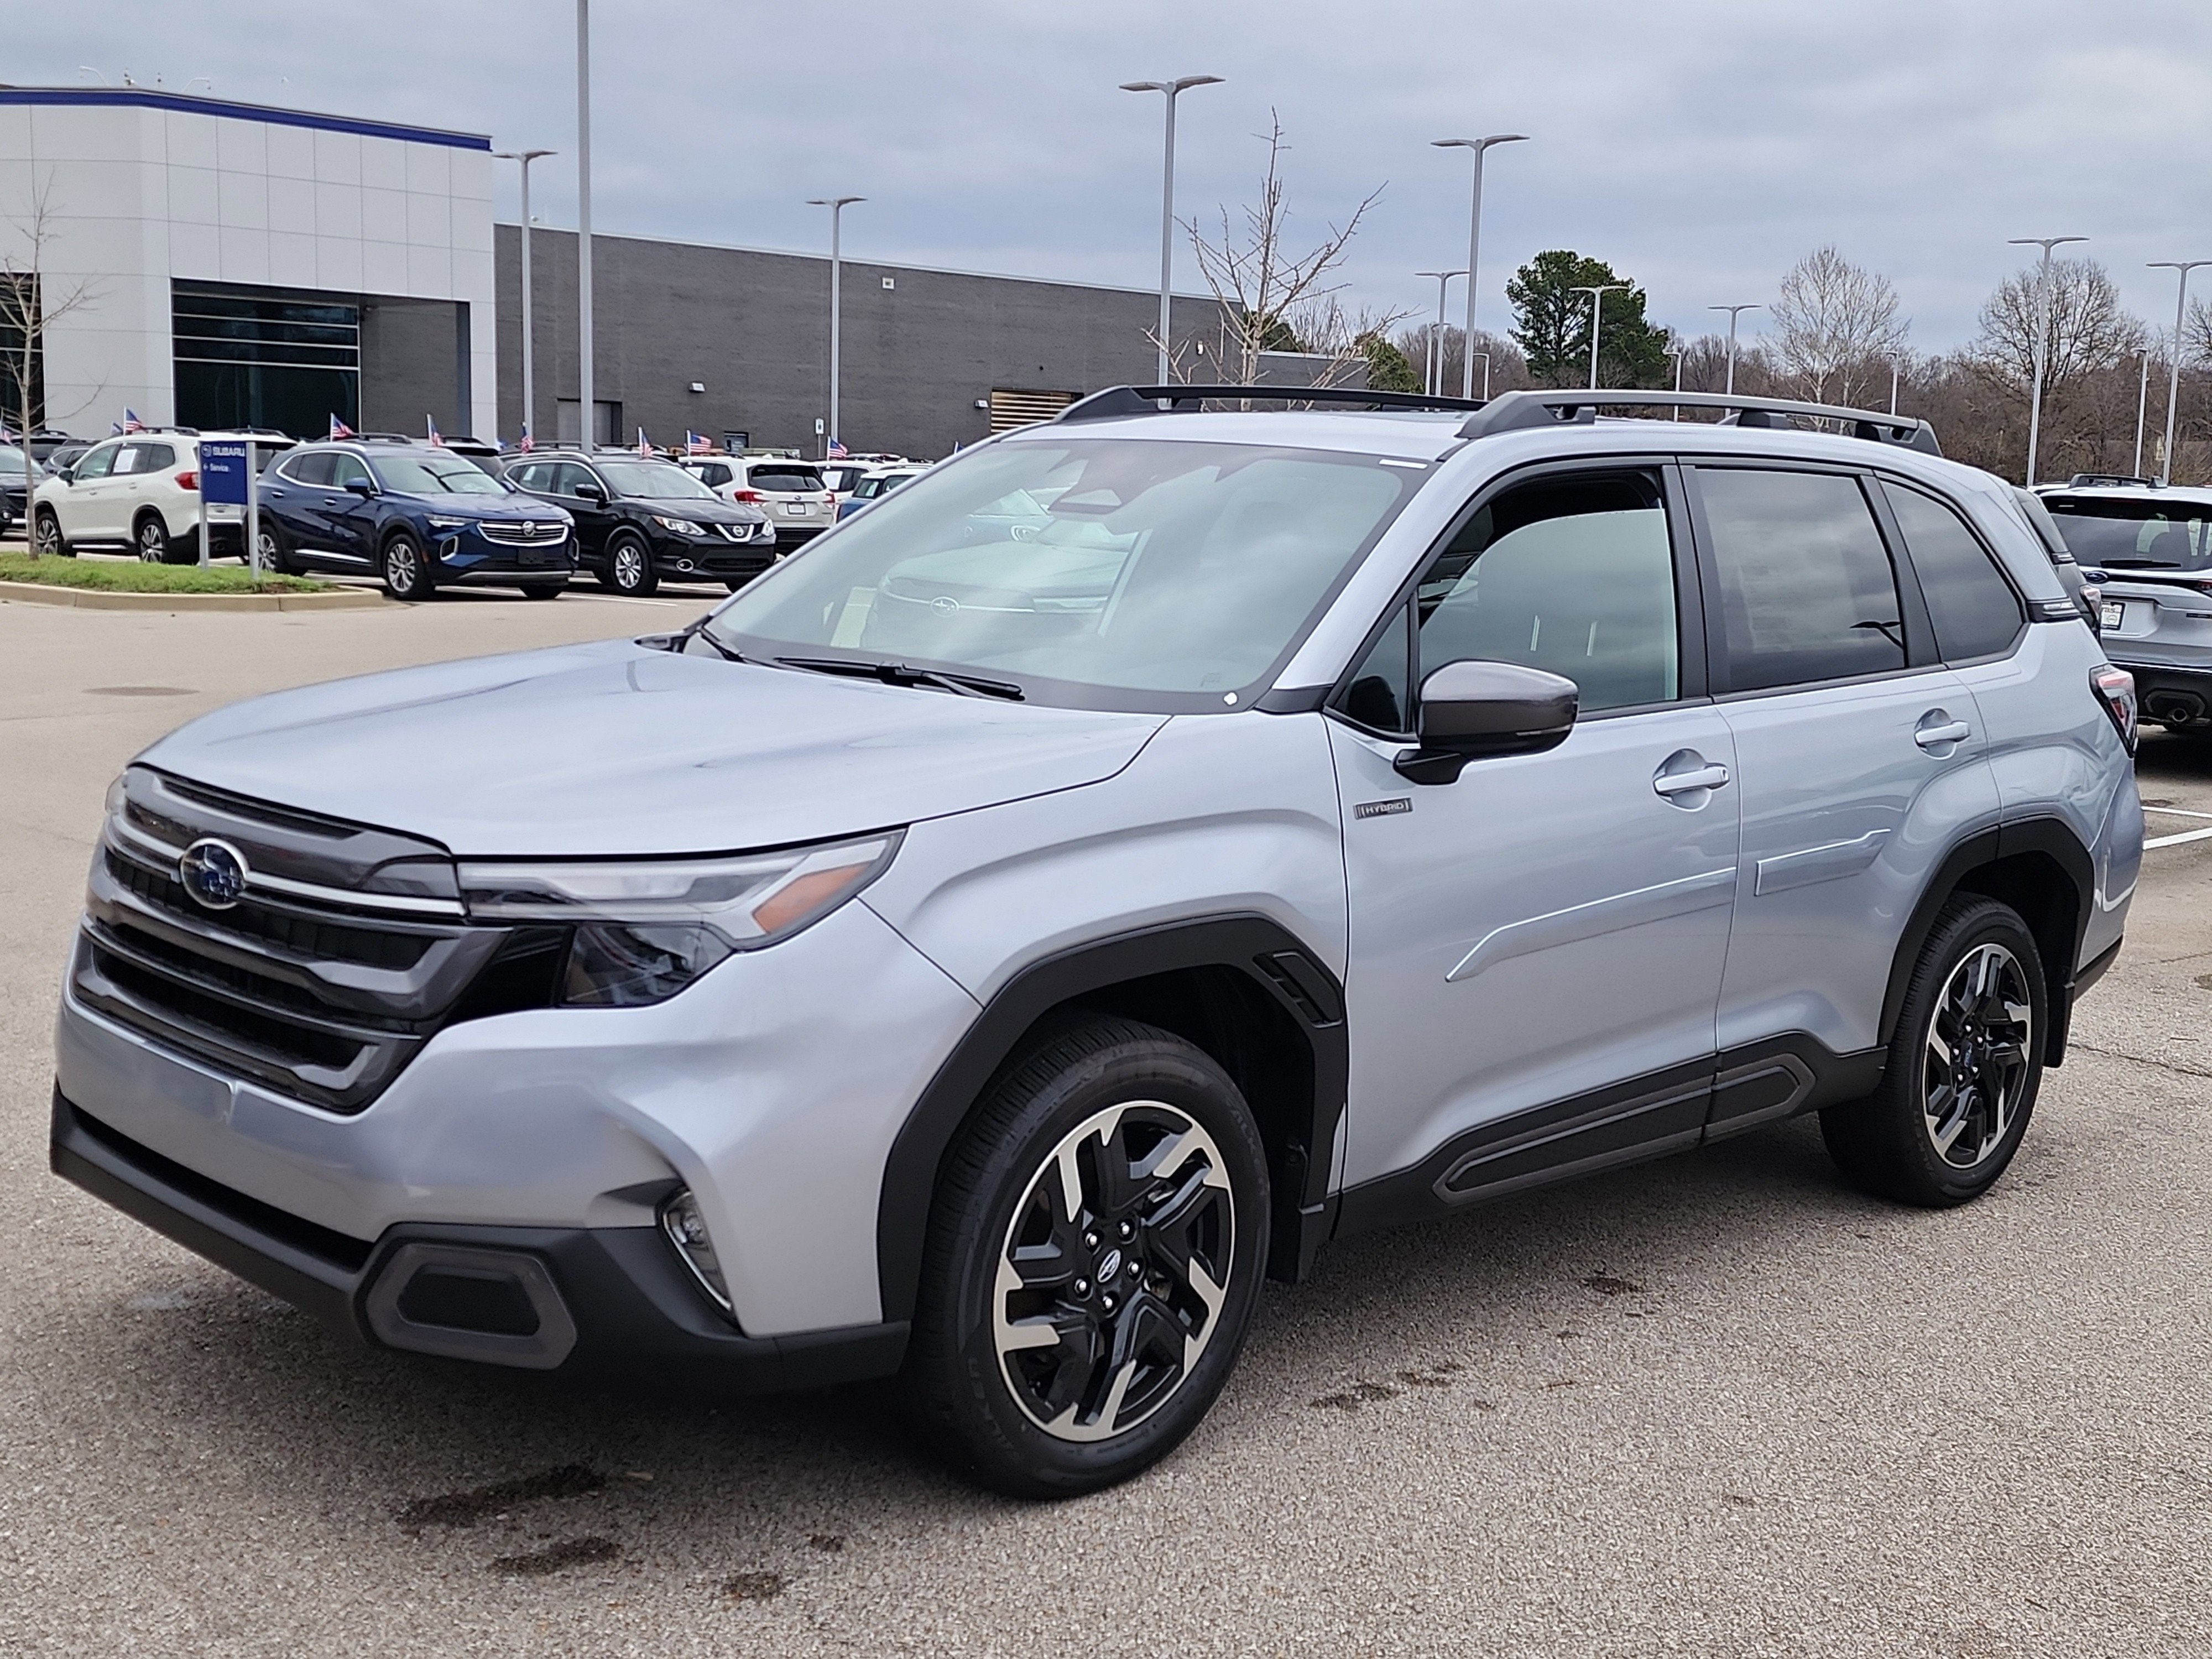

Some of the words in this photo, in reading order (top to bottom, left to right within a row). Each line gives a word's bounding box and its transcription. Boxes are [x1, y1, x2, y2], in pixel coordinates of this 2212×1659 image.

[212, 446, 245, 457] SUBARU
[210, 462, 229, 472] Service
[1365, 802, 1405, 814] HYBRID
